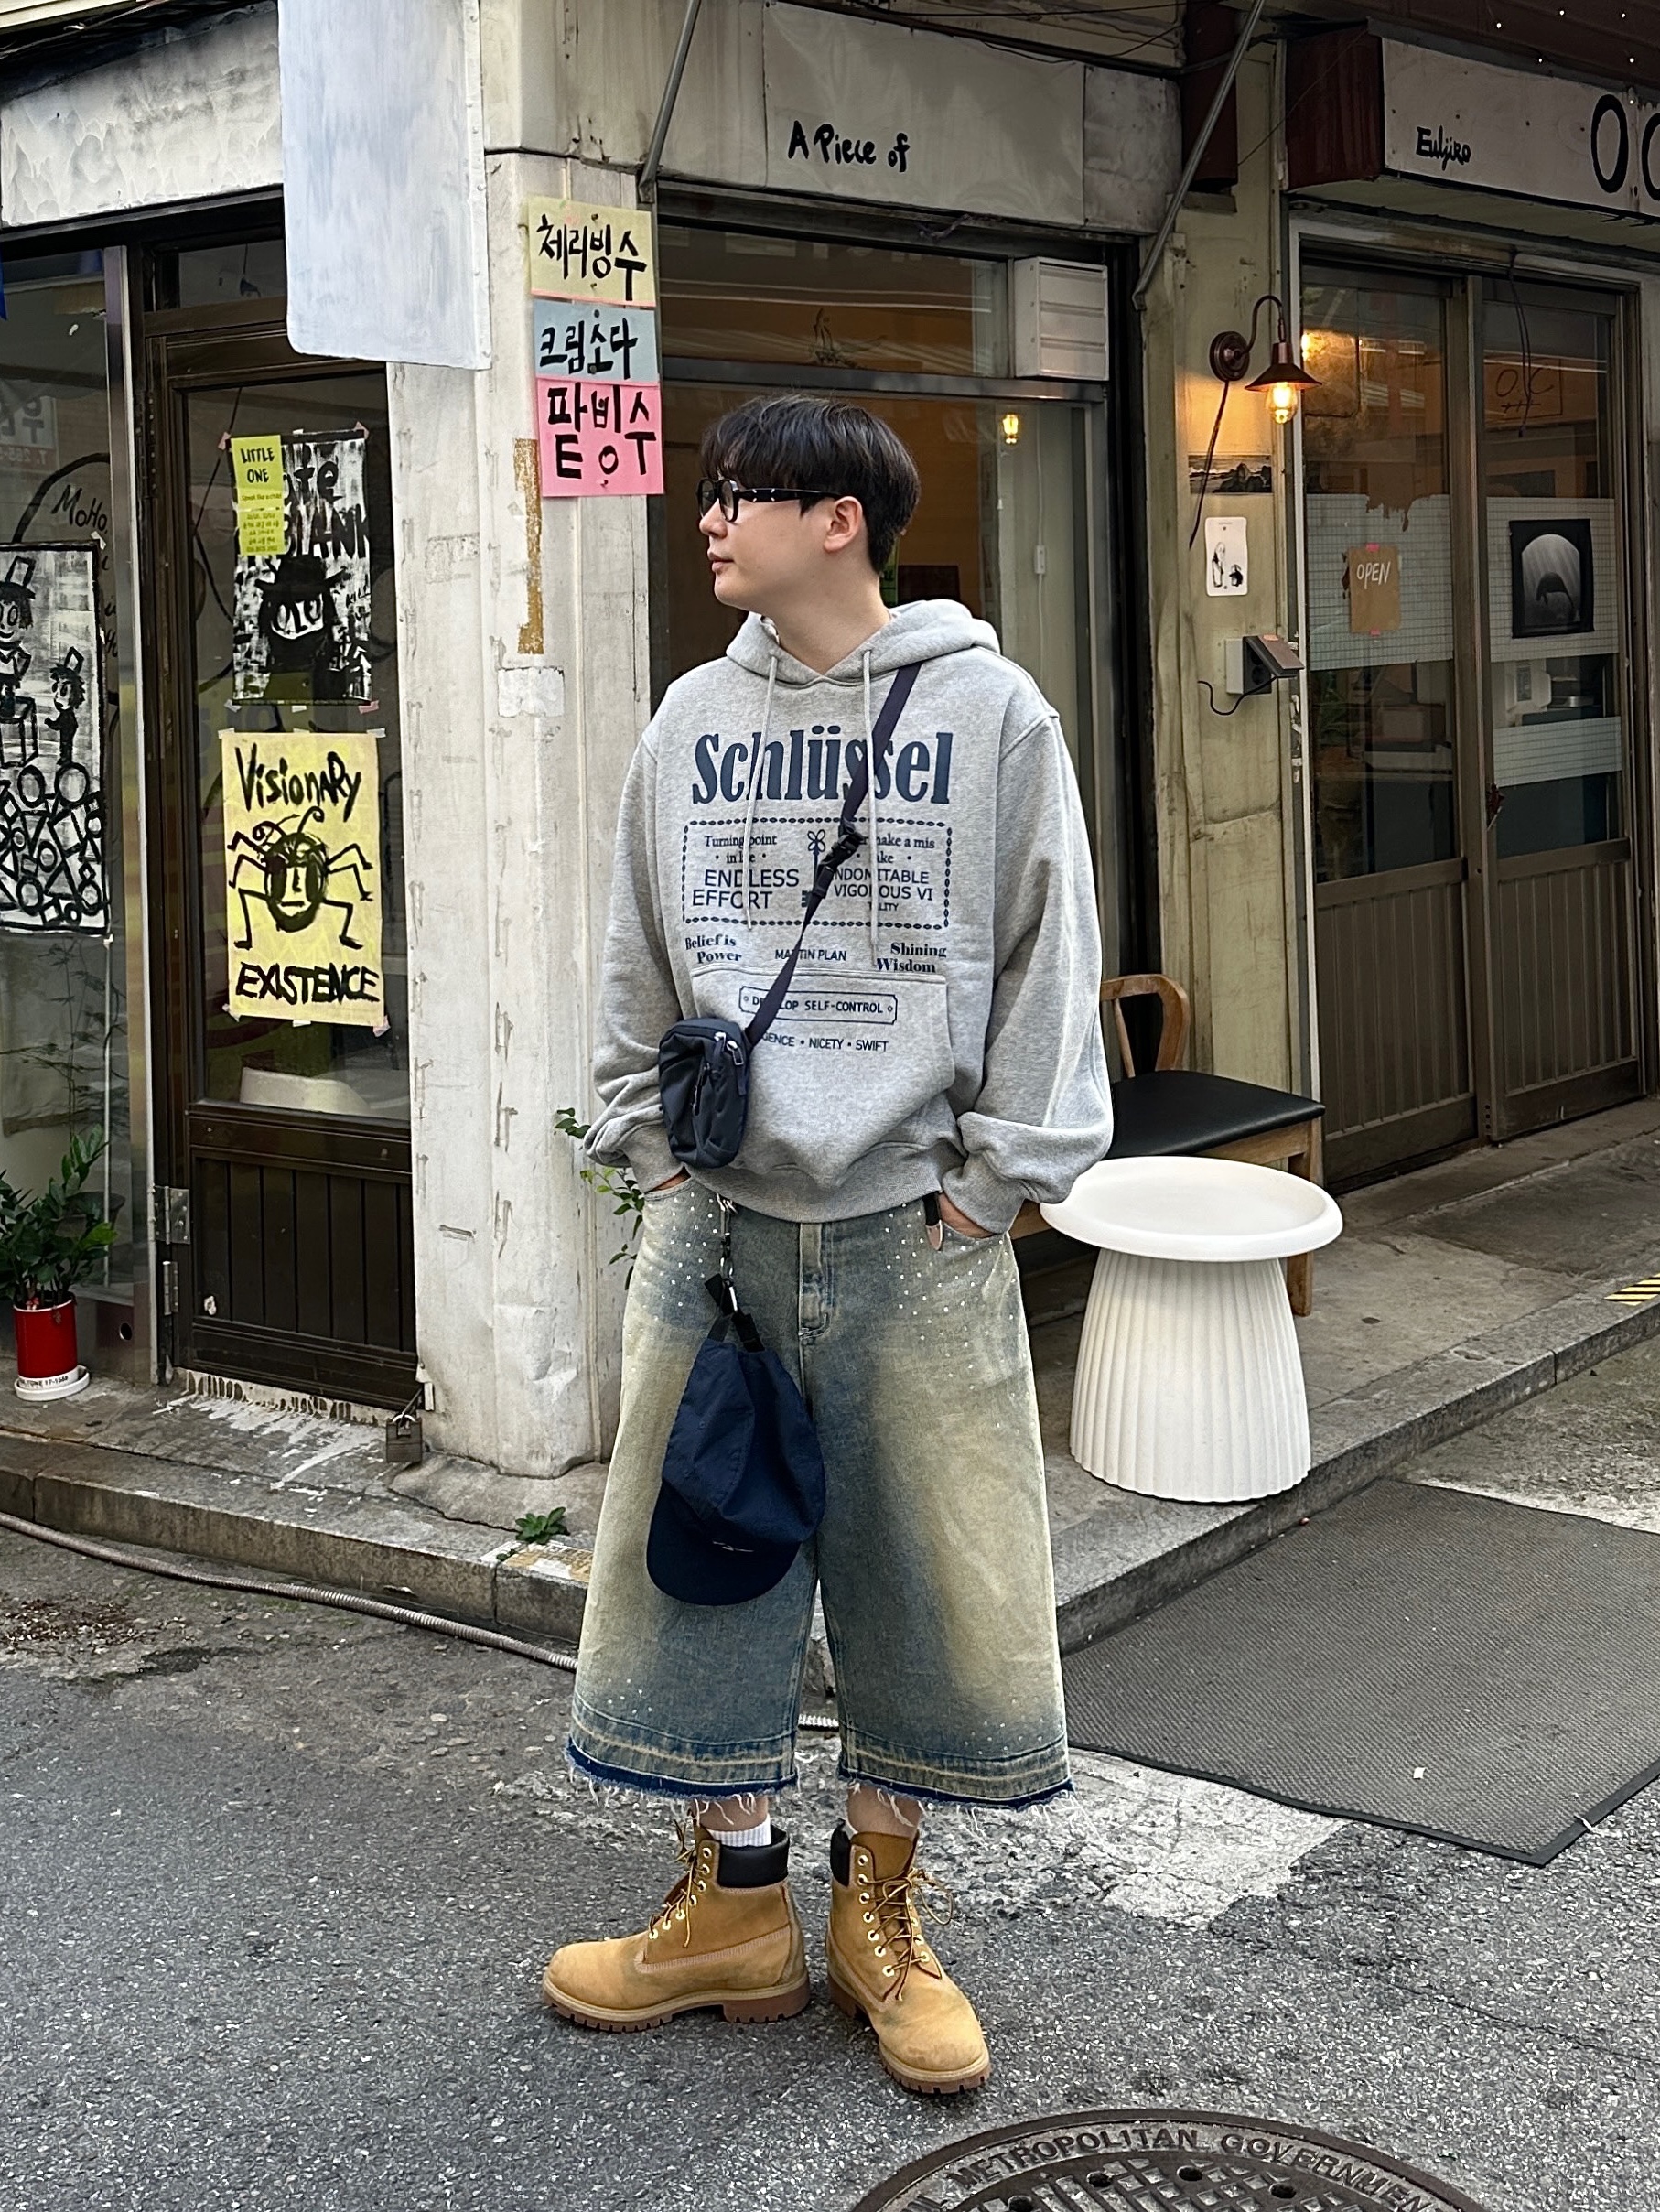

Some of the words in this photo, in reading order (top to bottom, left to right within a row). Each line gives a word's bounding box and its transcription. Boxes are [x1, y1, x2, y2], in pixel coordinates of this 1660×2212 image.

[788, 120, 810, 159] A
[814, 123, 877, 164] Piece
[888, 132, 911, 173] of
[536, 213, 647, 301] 체리빙수
[540, 318, 638, 380] 크림소다
[240, 447, 275, 464] LITTLE
[246, 468, 269, 483] ONE
[1356, 560, 1392, 590] OPEN
[903, 837, 911, 847] a
[913, 836, 935, 849] mis
[726, 852, 738, 864] in
[704, 869, 800, 888] ENDLESS
[692, 889, 773, 910] EFFORT
[834, 883, 911, 900] VIGOOUS
[917, 886, 933, 901] VI
[684, 933, 723, 950] Belief
[724, 934, 737, 947] is
[890, 942, 947, 958] Shining
[696, 951, 742, 964] Power
[774, 948, 815, 960] MATIN
[817, 949, 847, 961] PLAN
[876, 957, 936, 973] Wisdom
[235, 961, 381, 1005] EXISTENCE
[804, 1000, 884, 1014] SELF-CONTROL
[808, 1038, 844, 1050] NICETY
[855, 1040, 889, 1052] SWIFT
[946, 2128, 1199, 2190] METROPOLITAN
